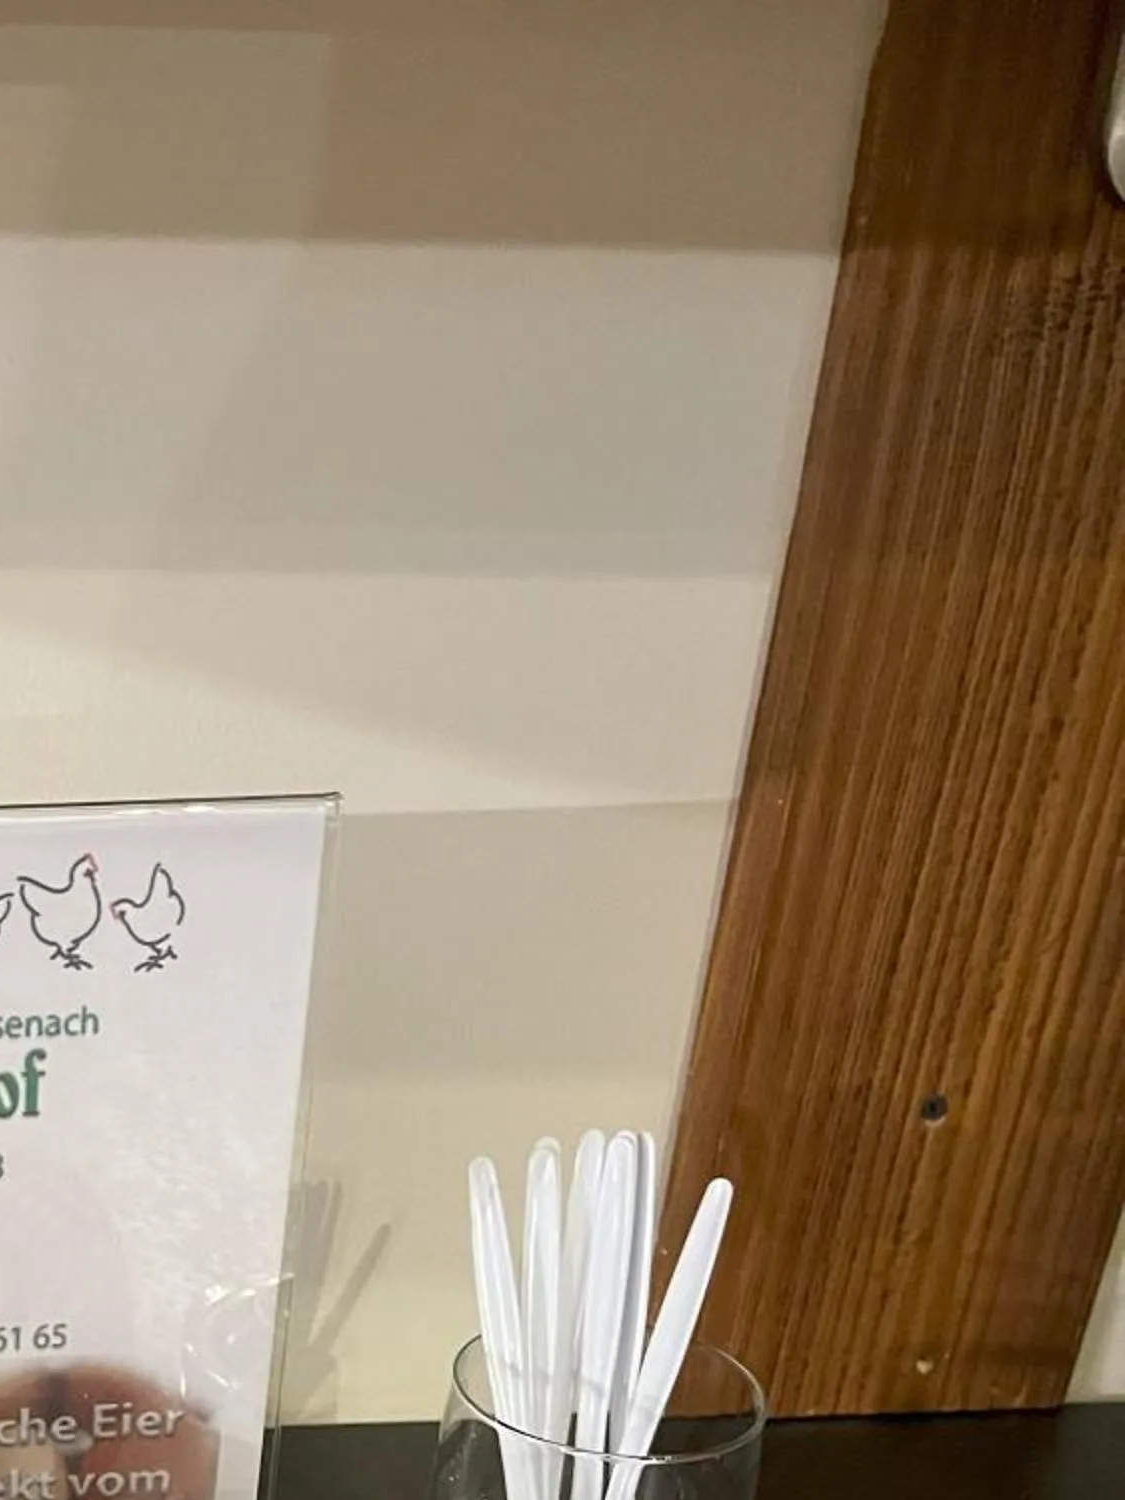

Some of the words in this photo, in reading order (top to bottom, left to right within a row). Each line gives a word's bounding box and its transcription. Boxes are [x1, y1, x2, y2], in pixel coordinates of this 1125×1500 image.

[33, 1322, 68, 1349] 65
[91, 1404, 186, 1440] Eier
[67, 1469, 171, 1496] vom
